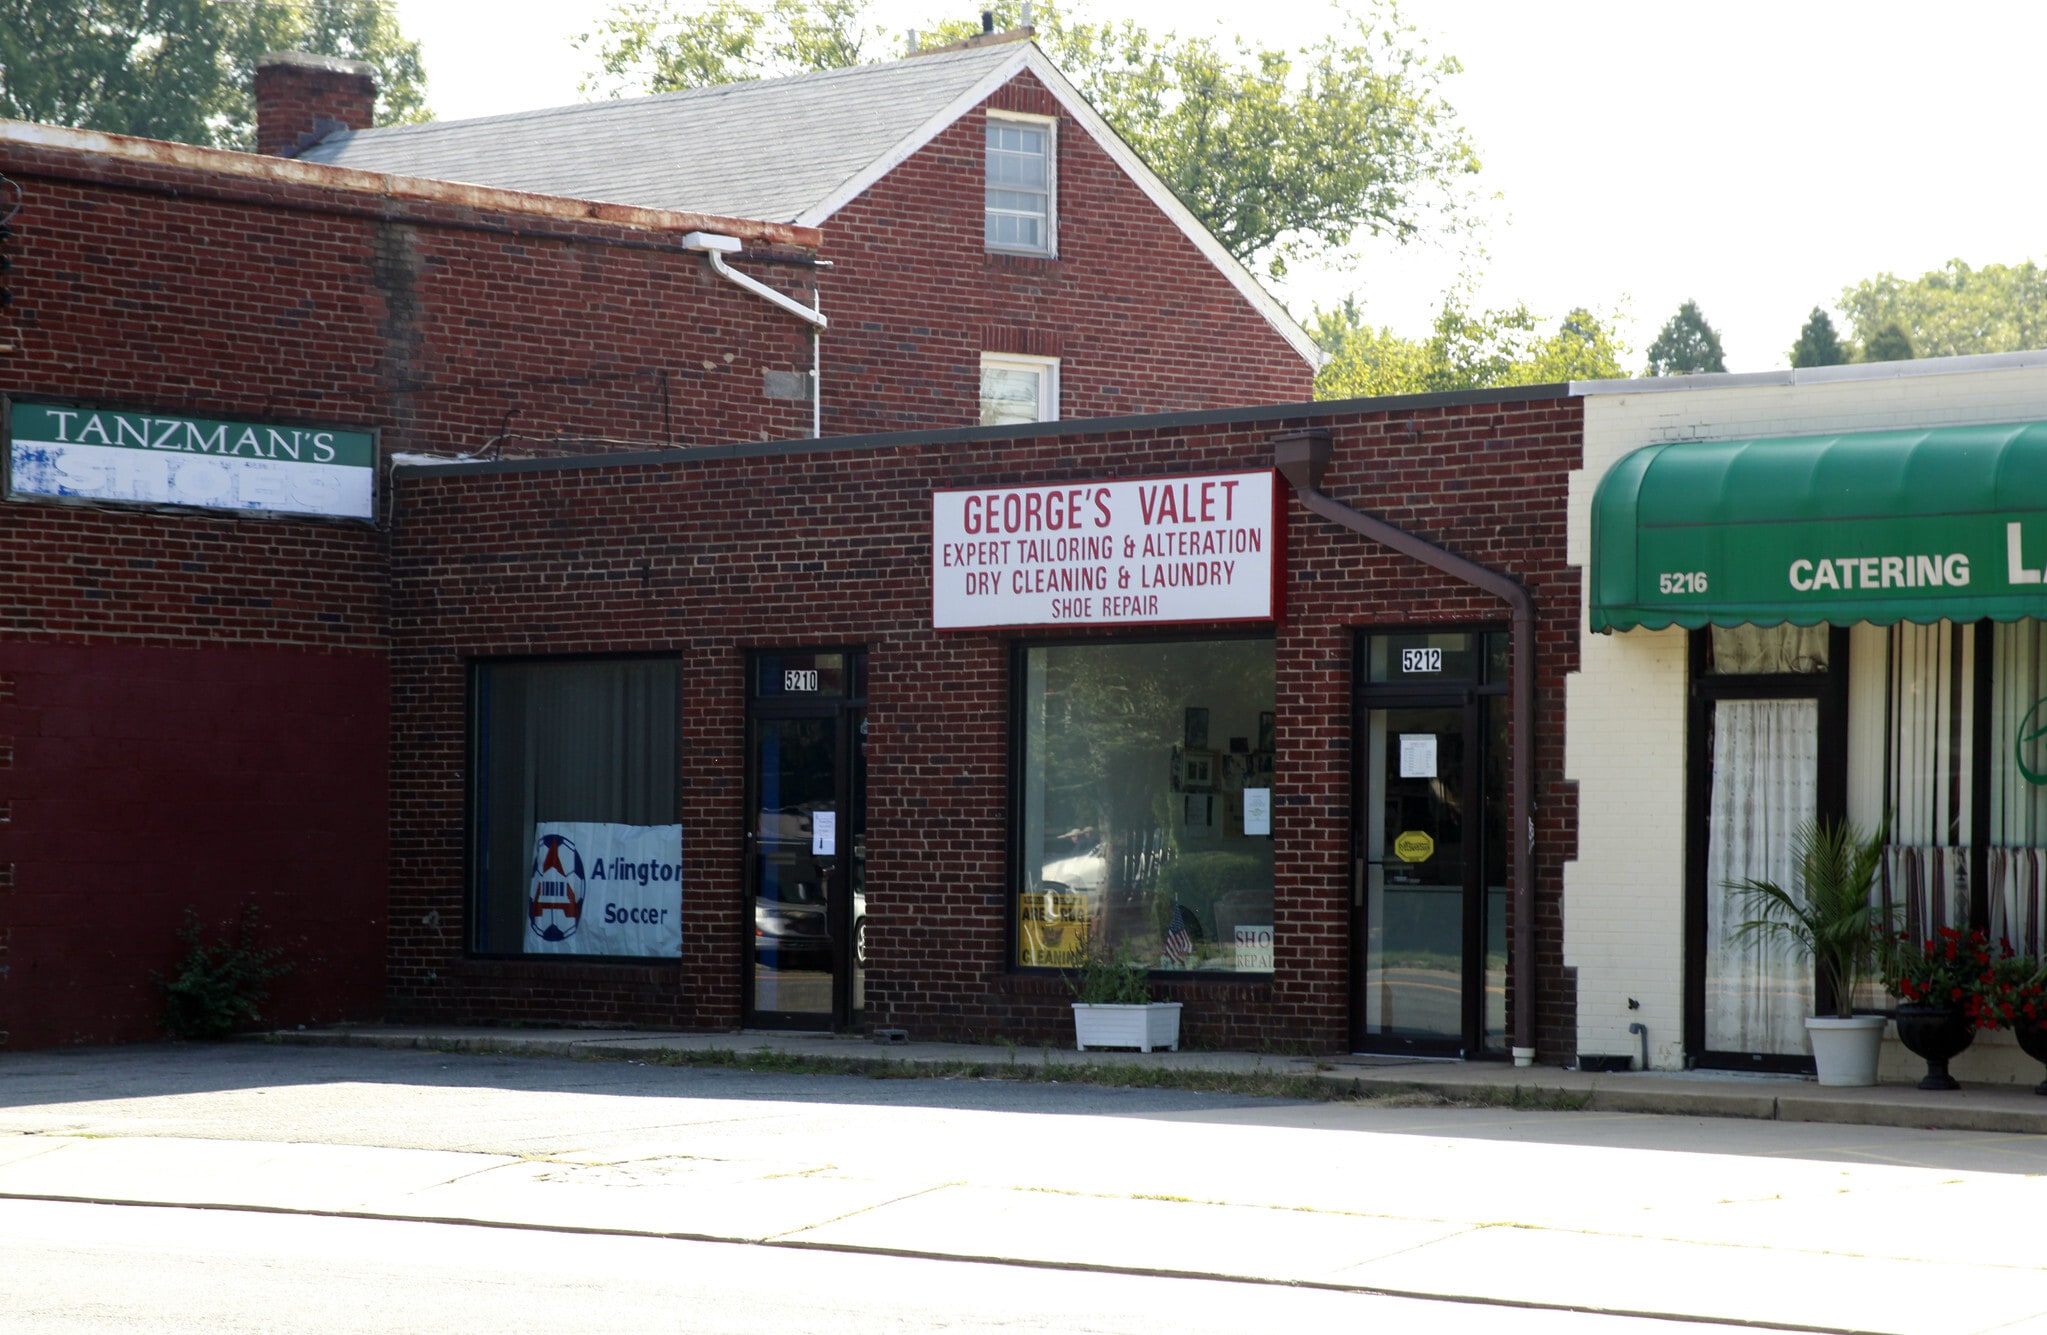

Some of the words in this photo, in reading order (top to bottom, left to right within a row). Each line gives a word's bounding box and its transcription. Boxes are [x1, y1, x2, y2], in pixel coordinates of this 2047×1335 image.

[46, 409, 336, 462] TANZMAN'S
[963, 488, 1112, 535] GEORGE'S
[1138, 480, 1239, 526] VALET
[943, 540, 1011, 567] EXPERT
[1017, 535, 1113, 564] TAILORING
[1123, 534, 1136, 559] &
[1142, 528, 1261, 558] ALTERATION
[2006, 521, 2047, 585] L
[966, 571, 1002, 596] DRY
[1012, 566, 1107, 595] CLEANING
[1118, 565, 1131, 590] &
[1141, 560, 1235, 588] LAUNDRY
[1659, 572, 1708, 595] 5216
[1789, 553, 1970, 591] CATERING
[1051, 597, 1092, 619] SHOE
[1102, 595, 1159, 617] REPAIR
[1403, 650, 1441, 671] 5212
[786, 671, 817, 691] 5210
[604, 902, 668, 925] Soccer
[1021, 906, 1053, 922] ARE
[1235, 929, 1274, 949] SHO
[1236, 954, 1274, 969] REPAI
